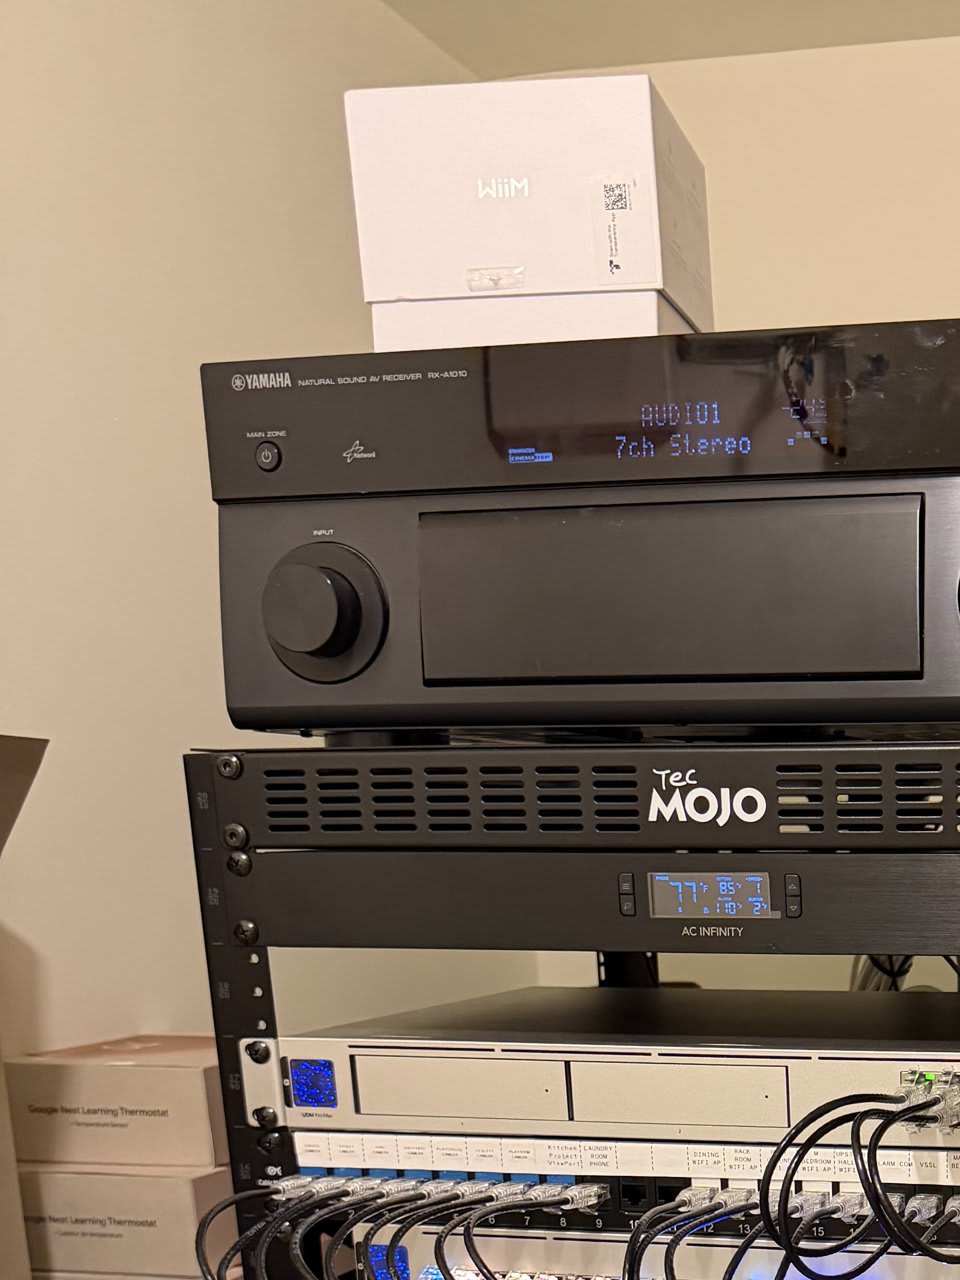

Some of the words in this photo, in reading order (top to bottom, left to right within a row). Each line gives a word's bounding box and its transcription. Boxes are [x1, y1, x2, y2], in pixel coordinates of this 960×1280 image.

[478, 176, 528, 199] WiiM
[245, 372, 292, 389] YAMAHA
[298, 377, 335, 387] NATURAL
[337, 375, 367, 385] SOUND
[369, 374, 381, 383] AV
[382, 372, 422, 382] RECEIVER
[427, 370, 468, 380] RX-A1010
[246, 431, 265, 439] MAIN
[266, 430, 287, 438] ZONE
[353, 450, 376, 460] Network
[652, 768, 698, 791] Tec
[648, 787, 767, 827] MOJO
[681, 926, 698, 937] AC
[699, 926, 744, 937] INFINITY
[60, 1106, 81, 1116] Nest
[81, 1106, 119, 1118] Learning
[120, 1107, 169, 1118] Thermostat
[69, 1217, 107, 1229] Learning
[108, 1217, 158, 1228] Thermostat
[524, 1216, 531, 1227] 7
[560, 1217, 567, 1228] 8
[595, 1218, 603, 1229] 9
[738, 1223, 751, 1234] 13
[812, 1226, 825, 1237] 15
